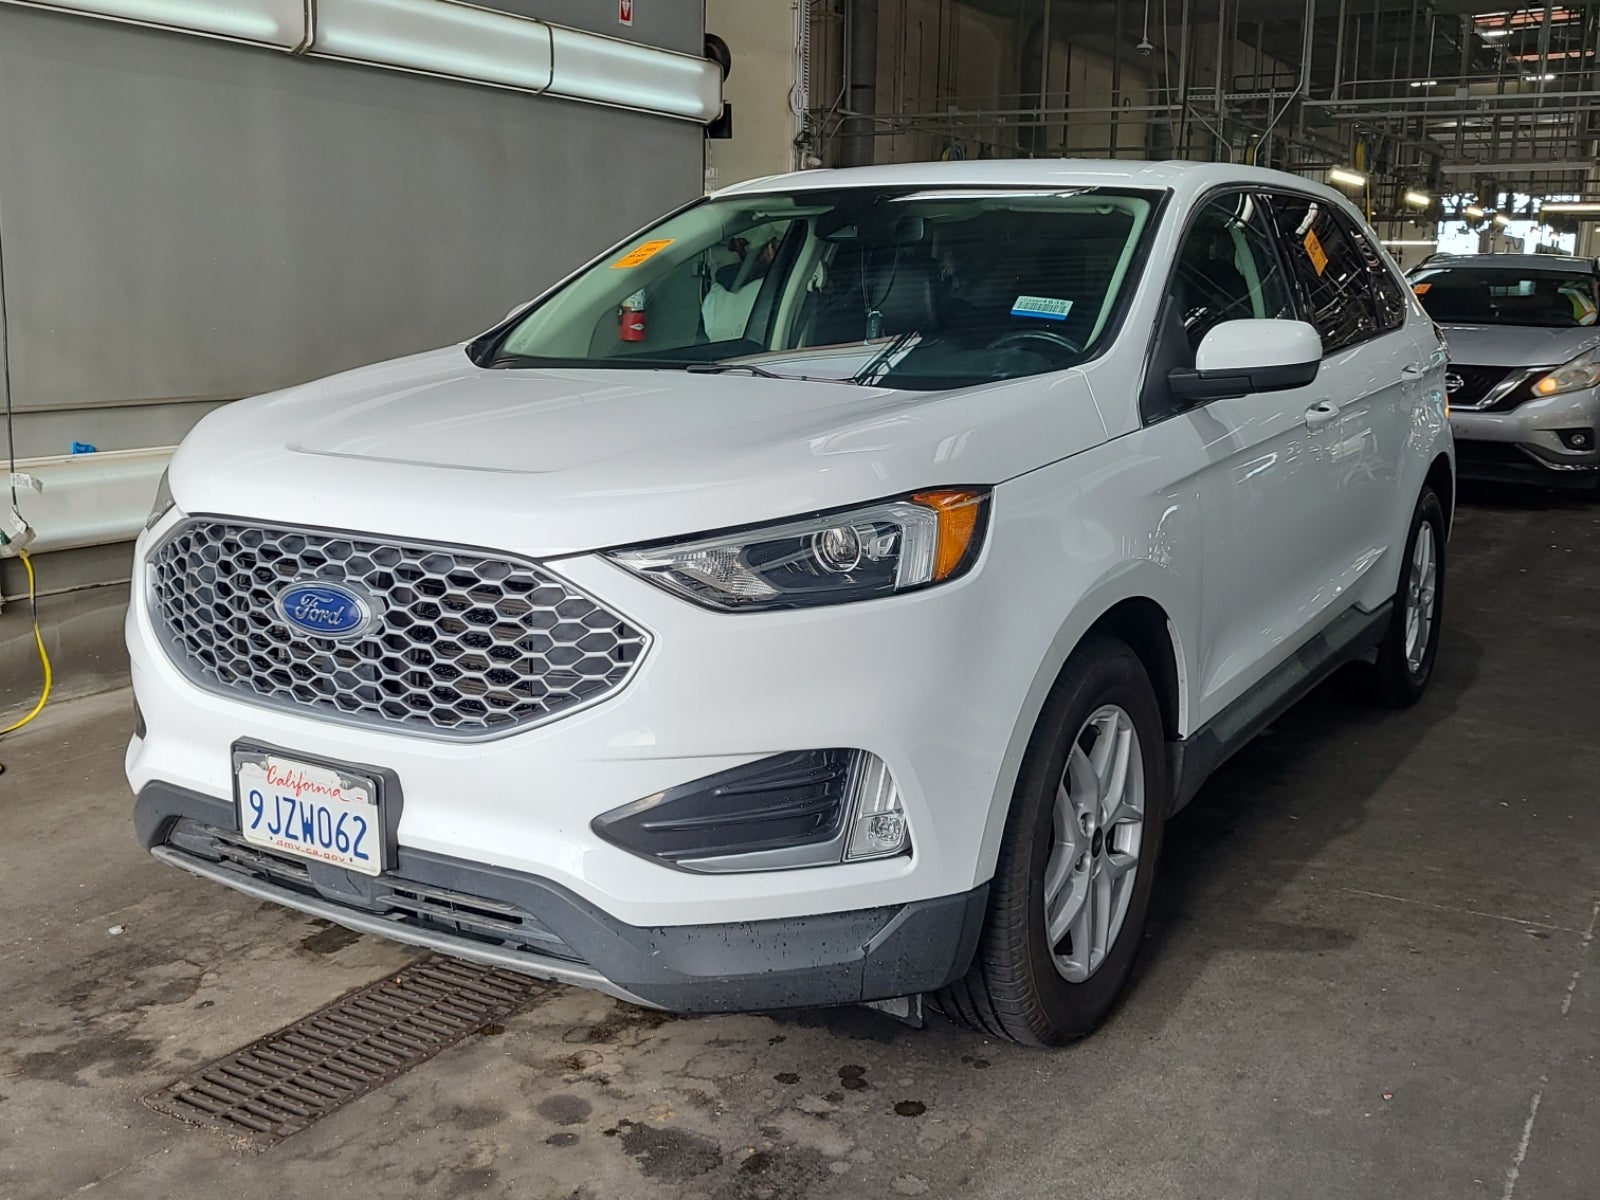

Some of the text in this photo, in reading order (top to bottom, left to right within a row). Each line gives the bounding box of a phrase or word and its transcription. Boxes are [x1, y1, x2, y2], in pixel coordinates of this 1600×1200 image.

[295, 593, 345, 625] Ford
[267, 765, 350, 802] California
[249, 789, 369, 860] 9JZW062
[275, 838, 346, 863] dmv.ca.gov
